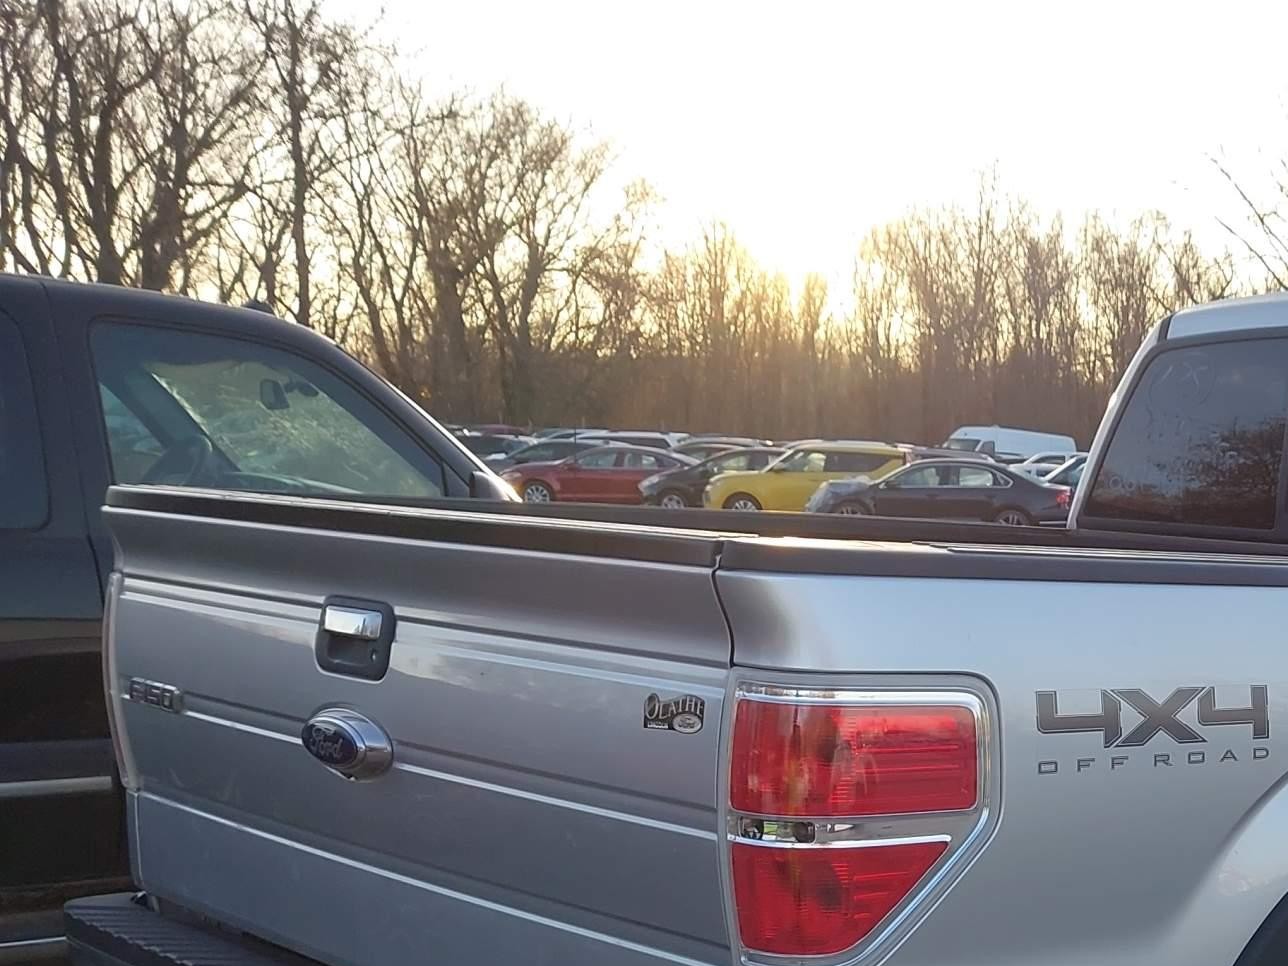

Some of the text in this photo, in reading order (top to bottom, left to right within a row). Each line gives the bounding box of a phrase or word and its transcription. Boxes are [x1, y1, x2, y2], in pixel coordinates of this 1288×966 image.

[644, 693, 704, 719] OLATHE
[310, 722, 345, 759] Ford
[1153, 747, 1270, 768] ROAD
